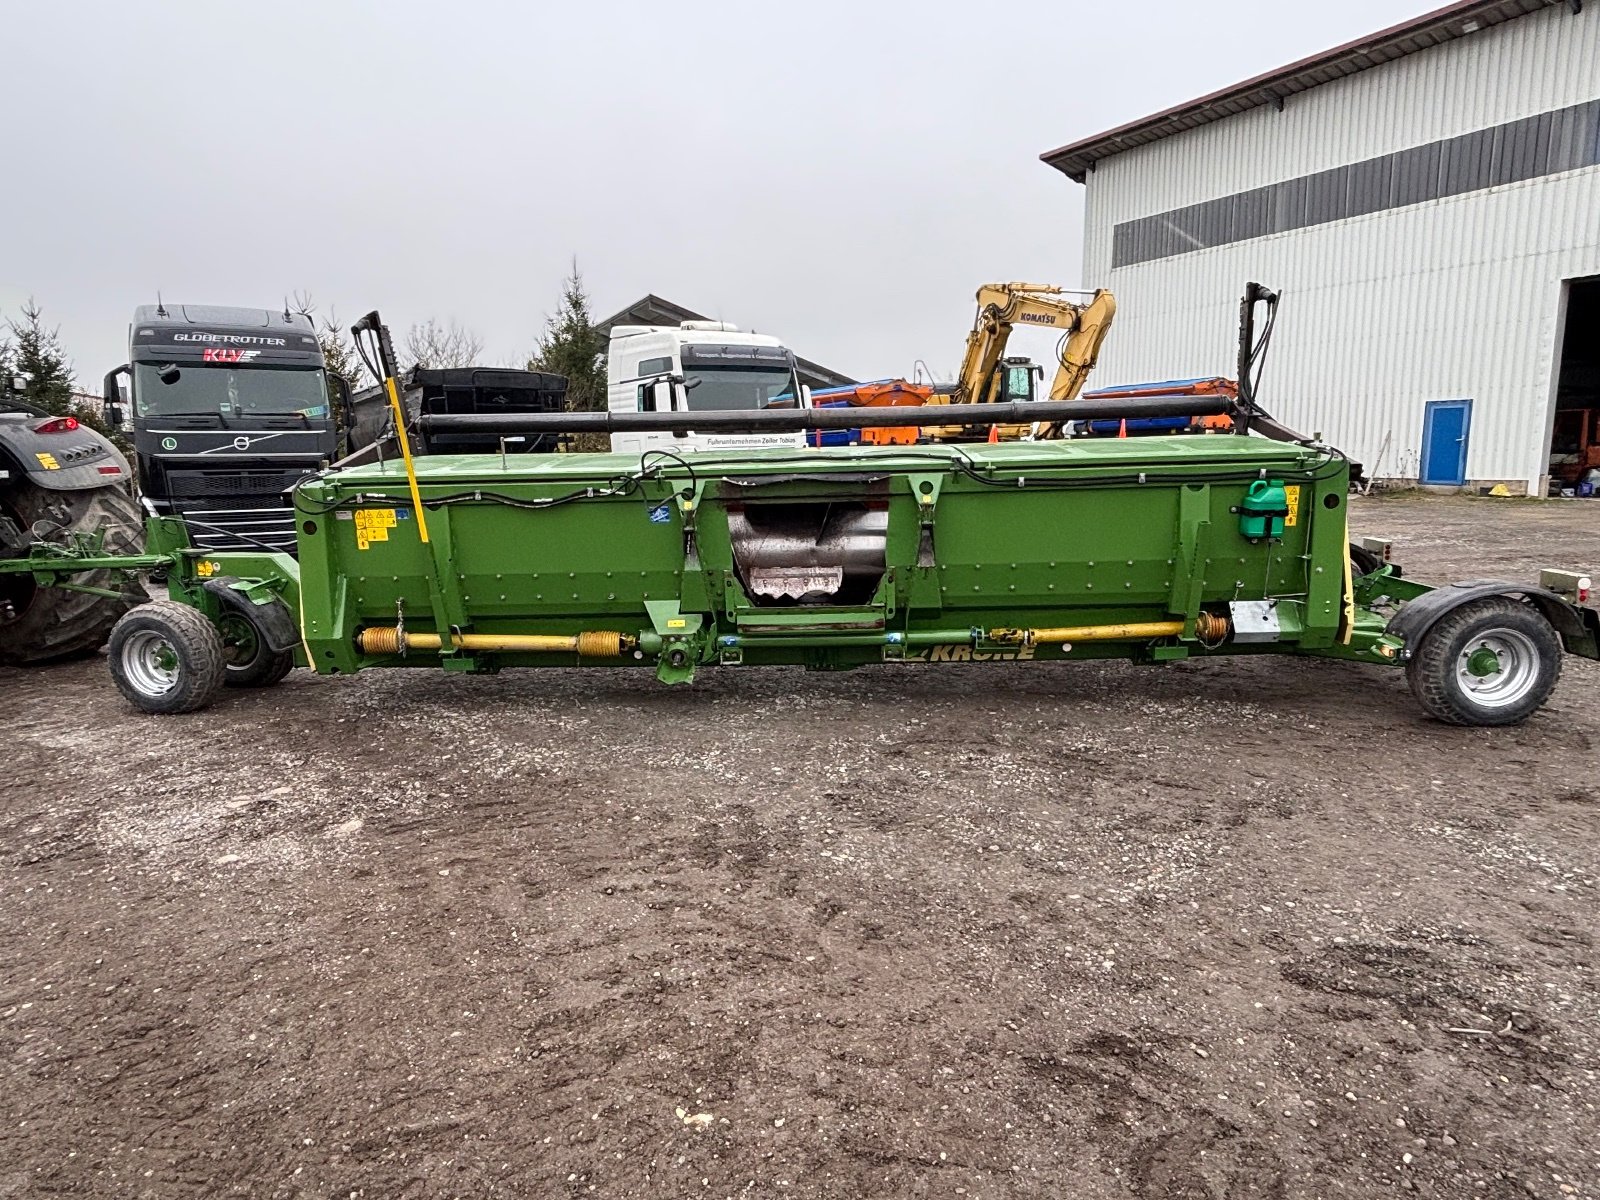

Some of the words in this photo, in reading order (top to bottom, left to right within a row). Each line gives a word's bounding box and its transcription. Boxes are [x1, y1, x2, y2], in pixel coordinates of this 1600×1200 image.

[1020, 312, 1056, 324] KOMATSU
[173, 333, 286, 346] GLOBETROTTER
[203, 348, 246, 362] KLV
